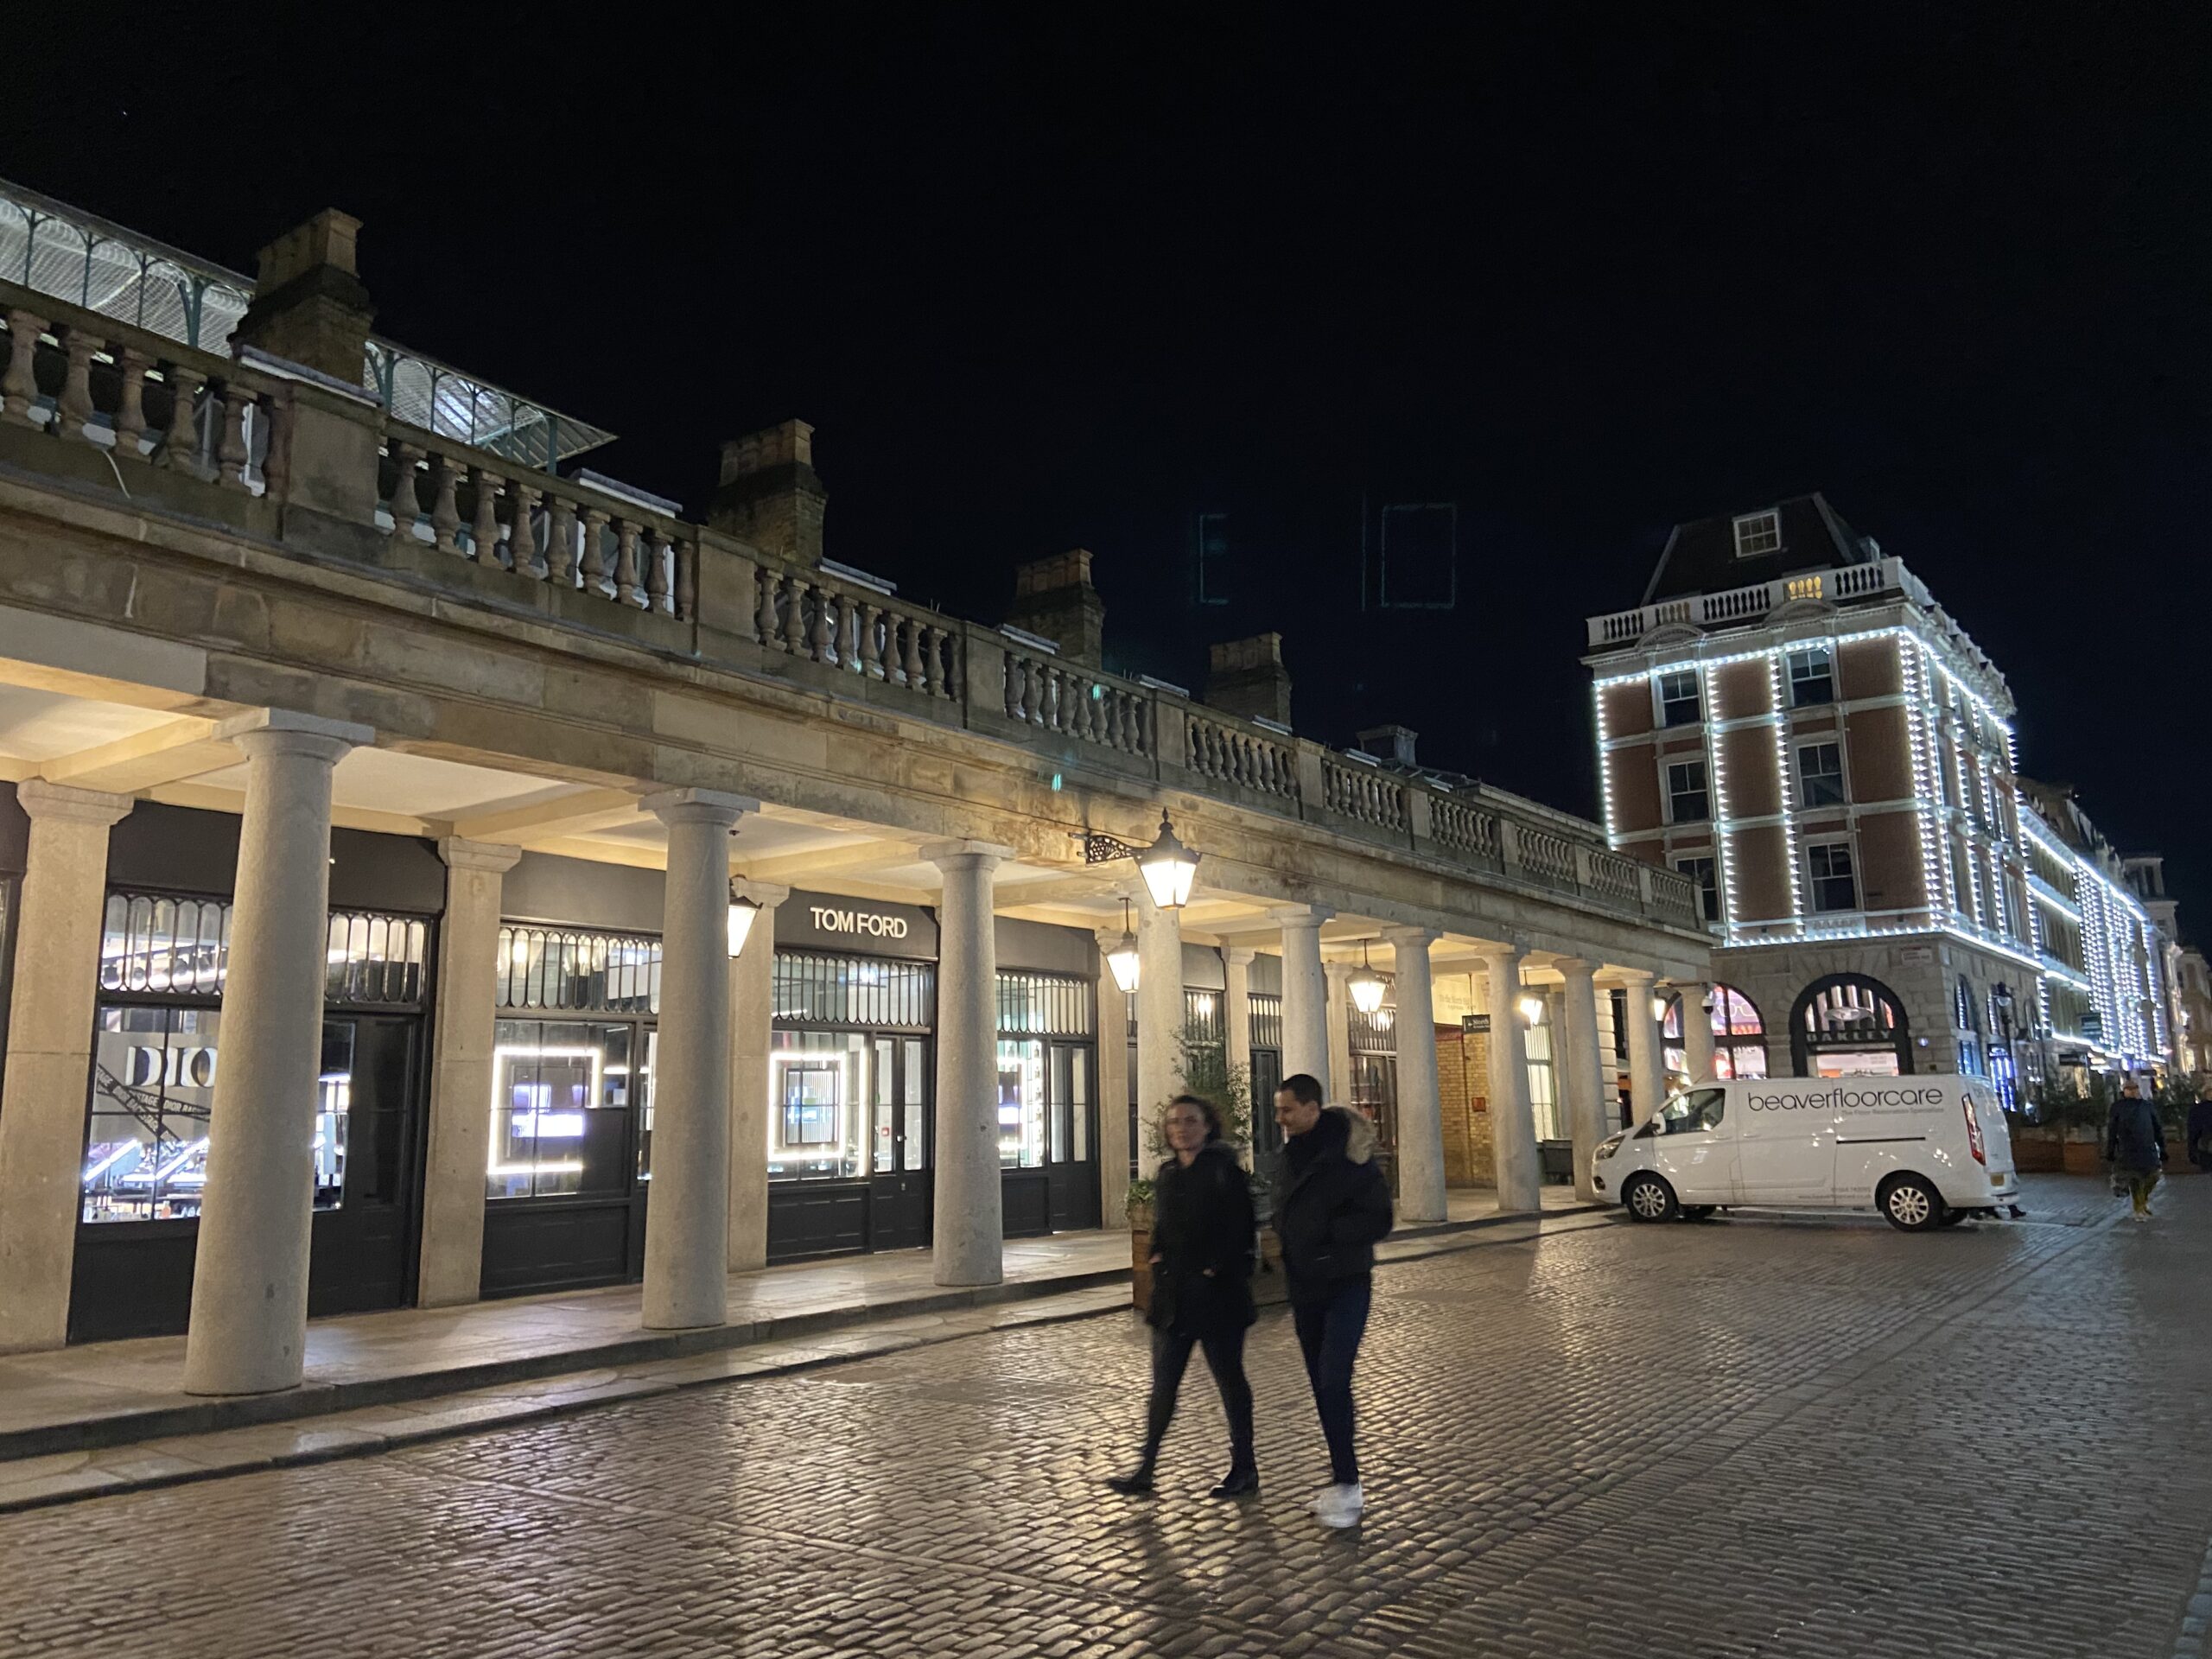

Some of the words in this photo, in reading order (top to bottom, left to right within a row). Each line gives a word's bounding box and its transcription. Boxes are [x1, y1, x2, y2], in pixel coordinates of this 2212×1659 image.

[810, 906, 854, 933] TOM
[856, 912, 908, 938] FORD
[1748, 1088, 1943, 1112] beaverfloorcare
